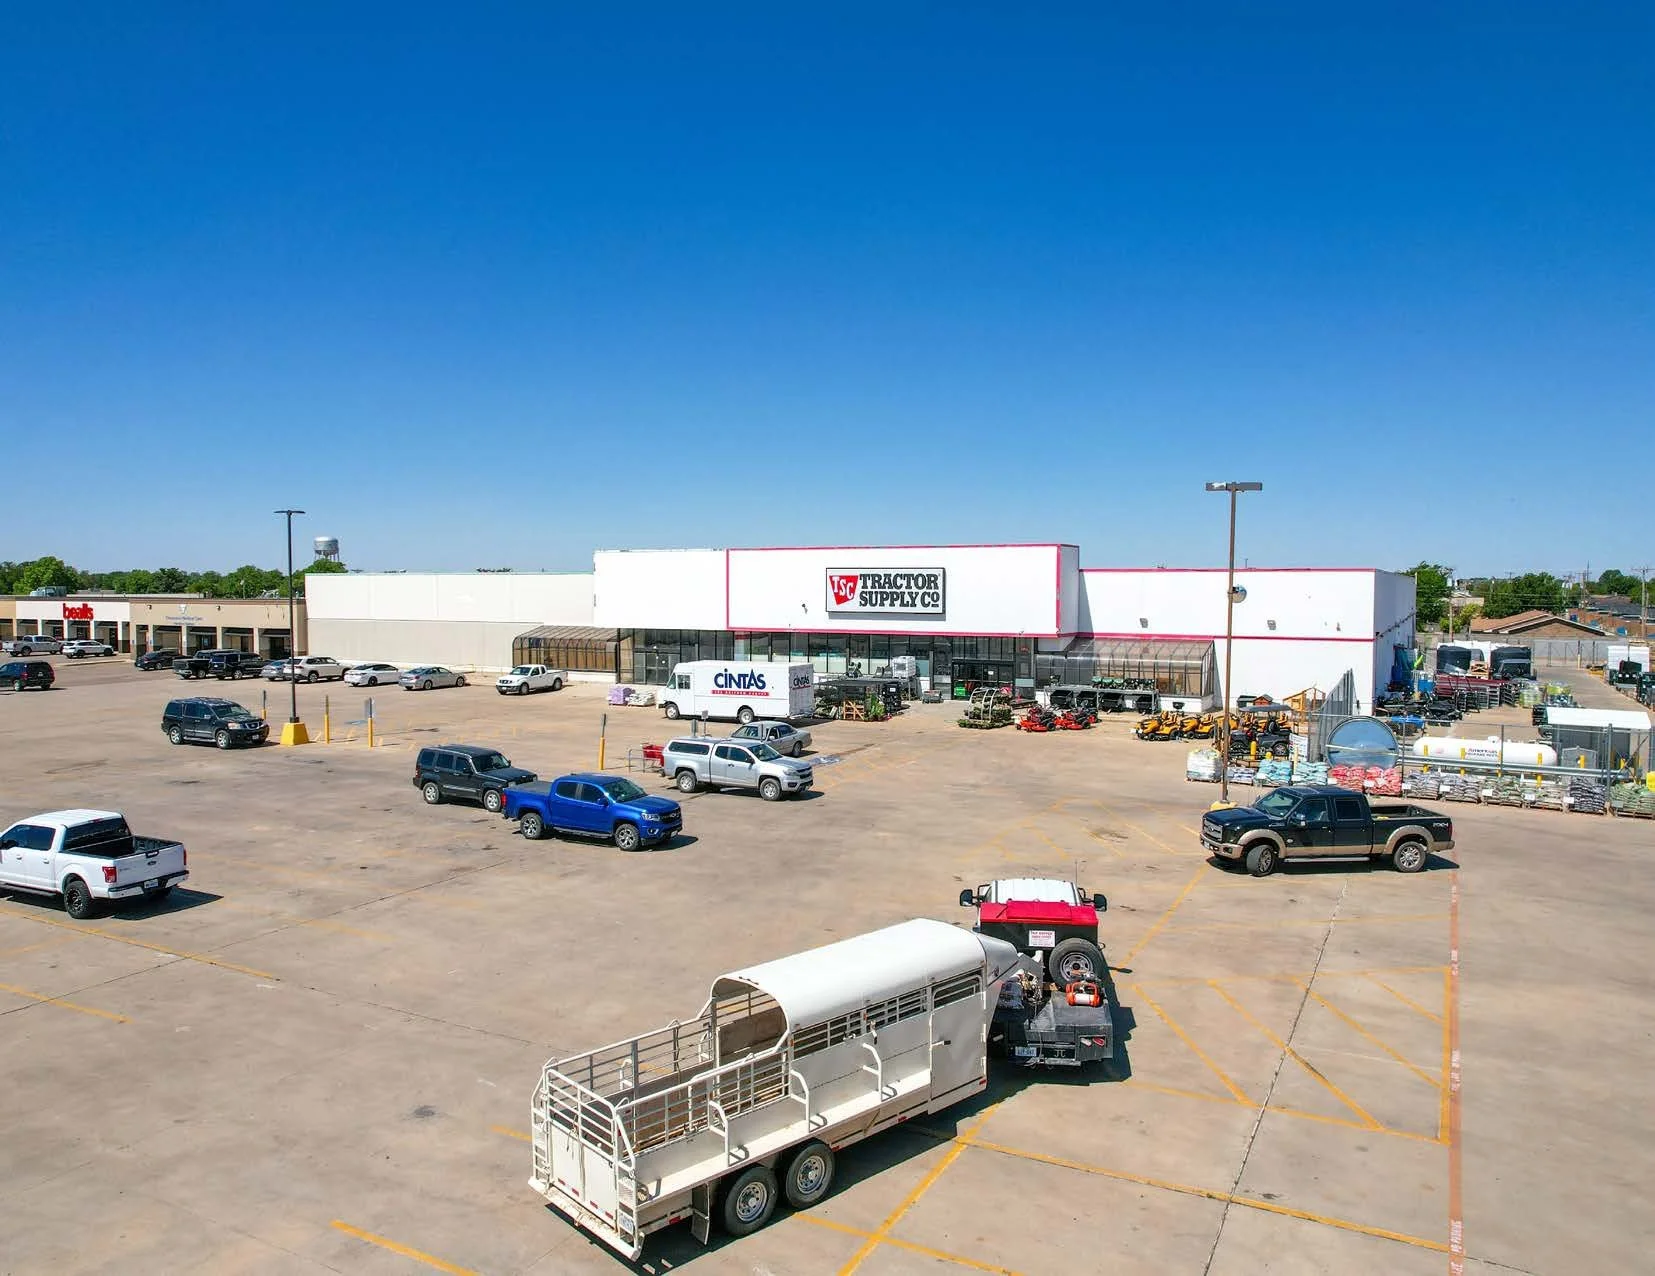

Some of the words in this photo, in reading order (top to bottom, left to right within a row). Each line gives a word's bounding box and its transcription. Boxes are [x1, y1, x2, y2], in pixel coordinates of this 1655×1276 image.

[832, 576, 854, 600] TSC
[859, 573, 940, 590] TRACTOR
[859, 591, 919, 608] SUPPLY
[62, 603, 94, 620] bealls
